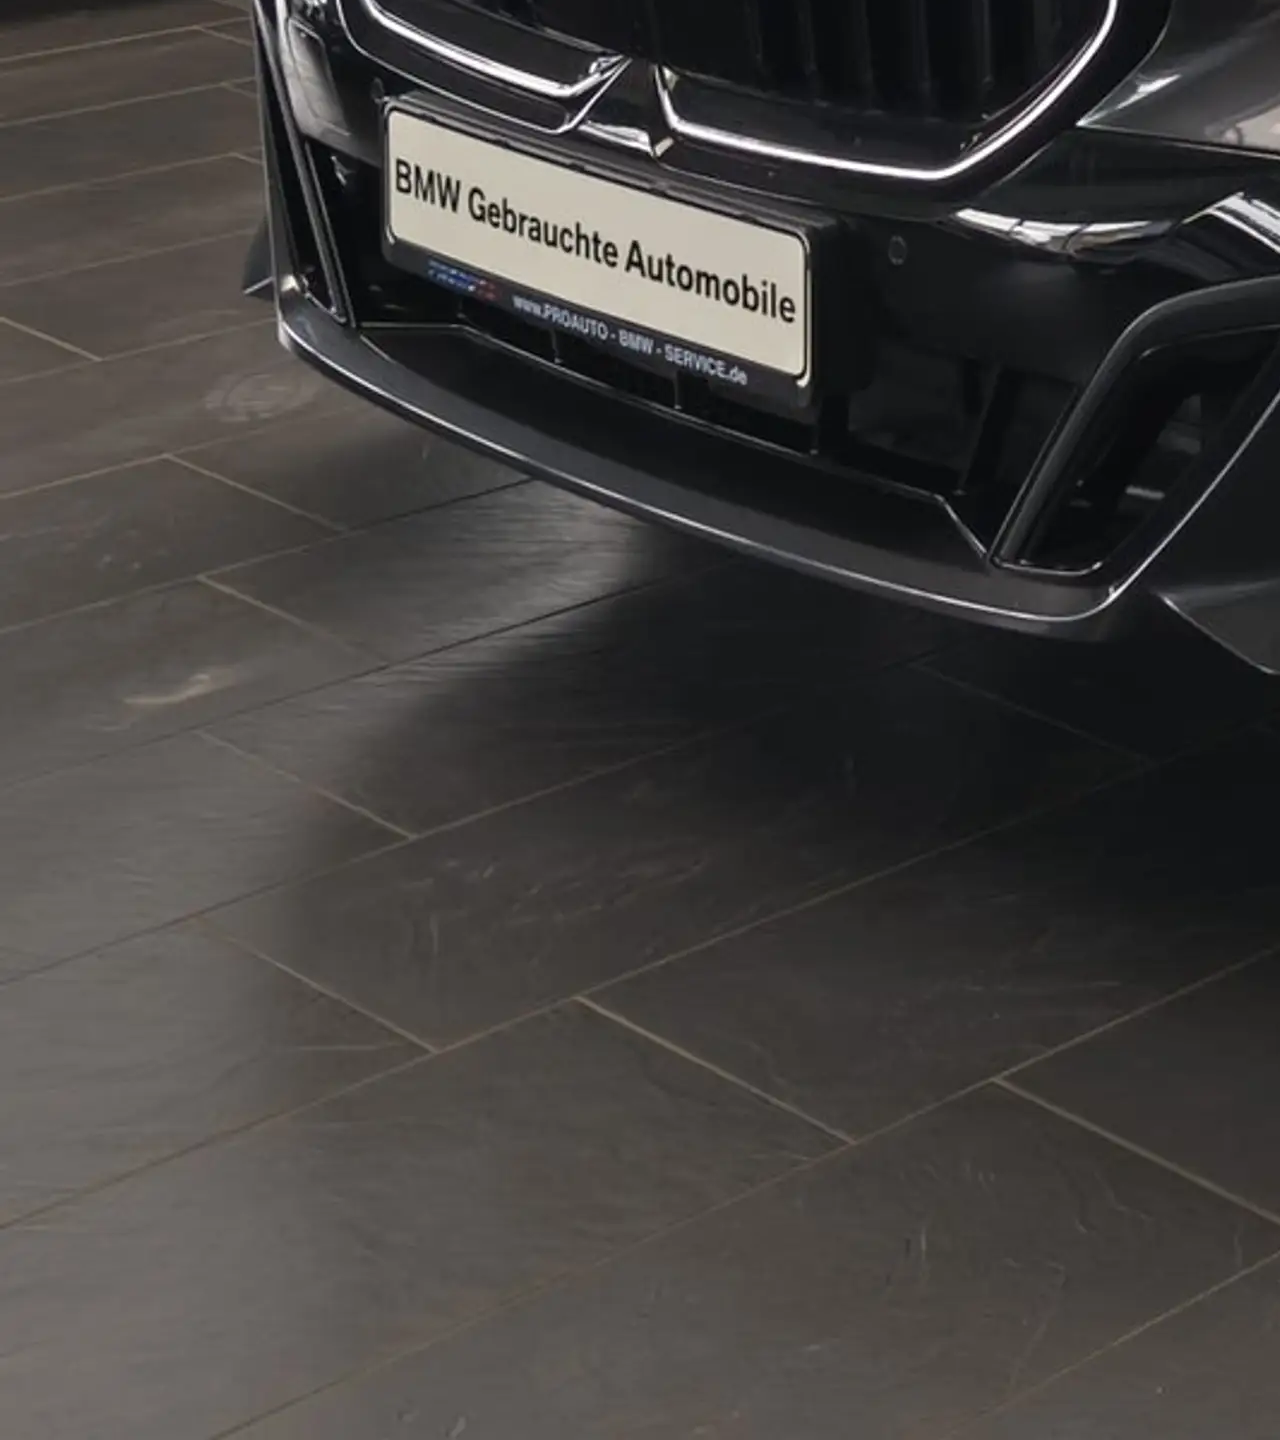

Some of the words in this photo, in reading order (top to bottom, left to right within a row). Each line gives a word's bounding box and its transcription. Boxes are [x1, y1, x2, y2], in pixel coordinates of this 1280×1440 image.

[395, 159, 461, 213] BMW
[467, 187, 619, 268] Gebrauchte
[624, 239, 797, 324] Automobile
[618, 329, 655, 355] BMW
